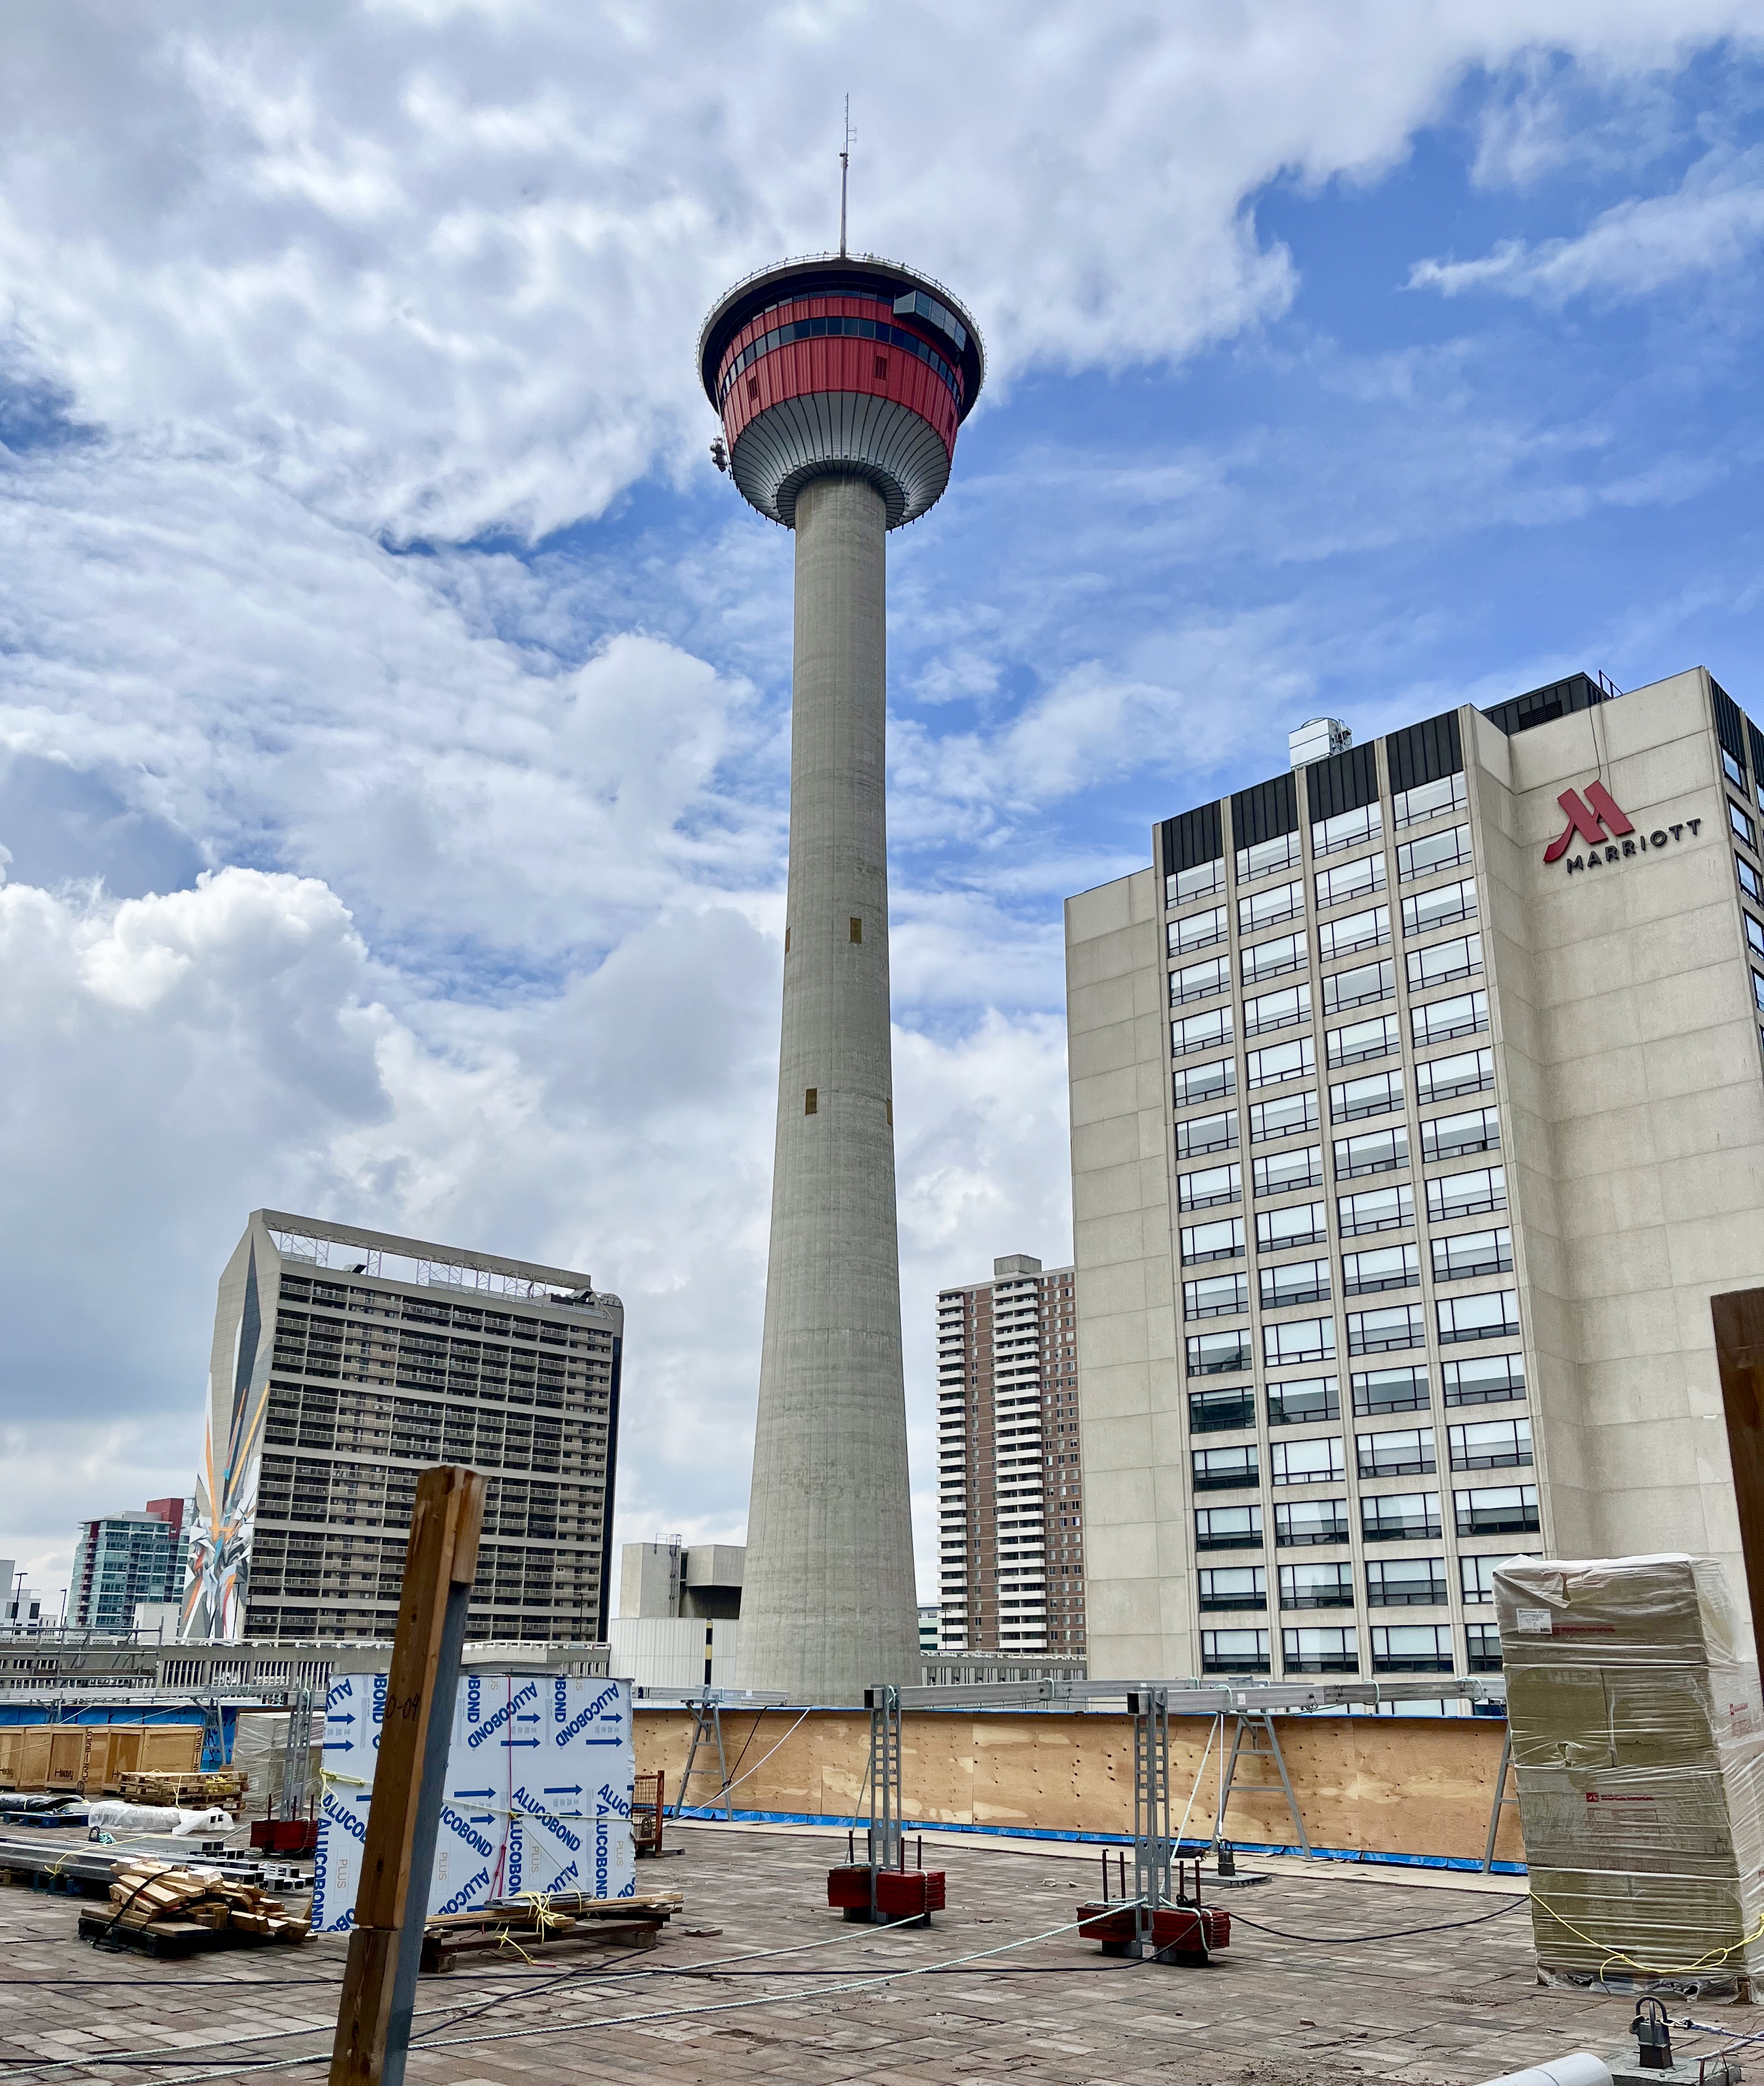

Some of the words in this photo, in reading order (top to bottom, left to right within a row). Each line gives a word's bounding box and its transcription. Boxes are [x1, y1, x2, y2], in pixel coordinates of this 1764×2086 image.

[1566, 818, 1701, 874] MARRIOTT
[325, 1678, 353, 1714] ALU
[372, 1673, 387, 1724] BOND
[468, 1675, 480, 1723] BOND
[468, 1681, 538, 1748] ALUCOBOND
[555, 1676, 566, 1723] BOND
[555, 1682, 620, 1746] ALUCOBOND
[54, 1767, 74, 1780] Heavy
[512, 1786, 580, 1852] ALUCOBOND
[337, 1859, 348, 1889] PLUS
[439, 1852, 448, 1881] PLUS
[531, 1846, 540, 1873] PLUS
[596, 1804, 609, 1900] ALUCOBOND
[541, 1860, 579, 1893] ALUC
